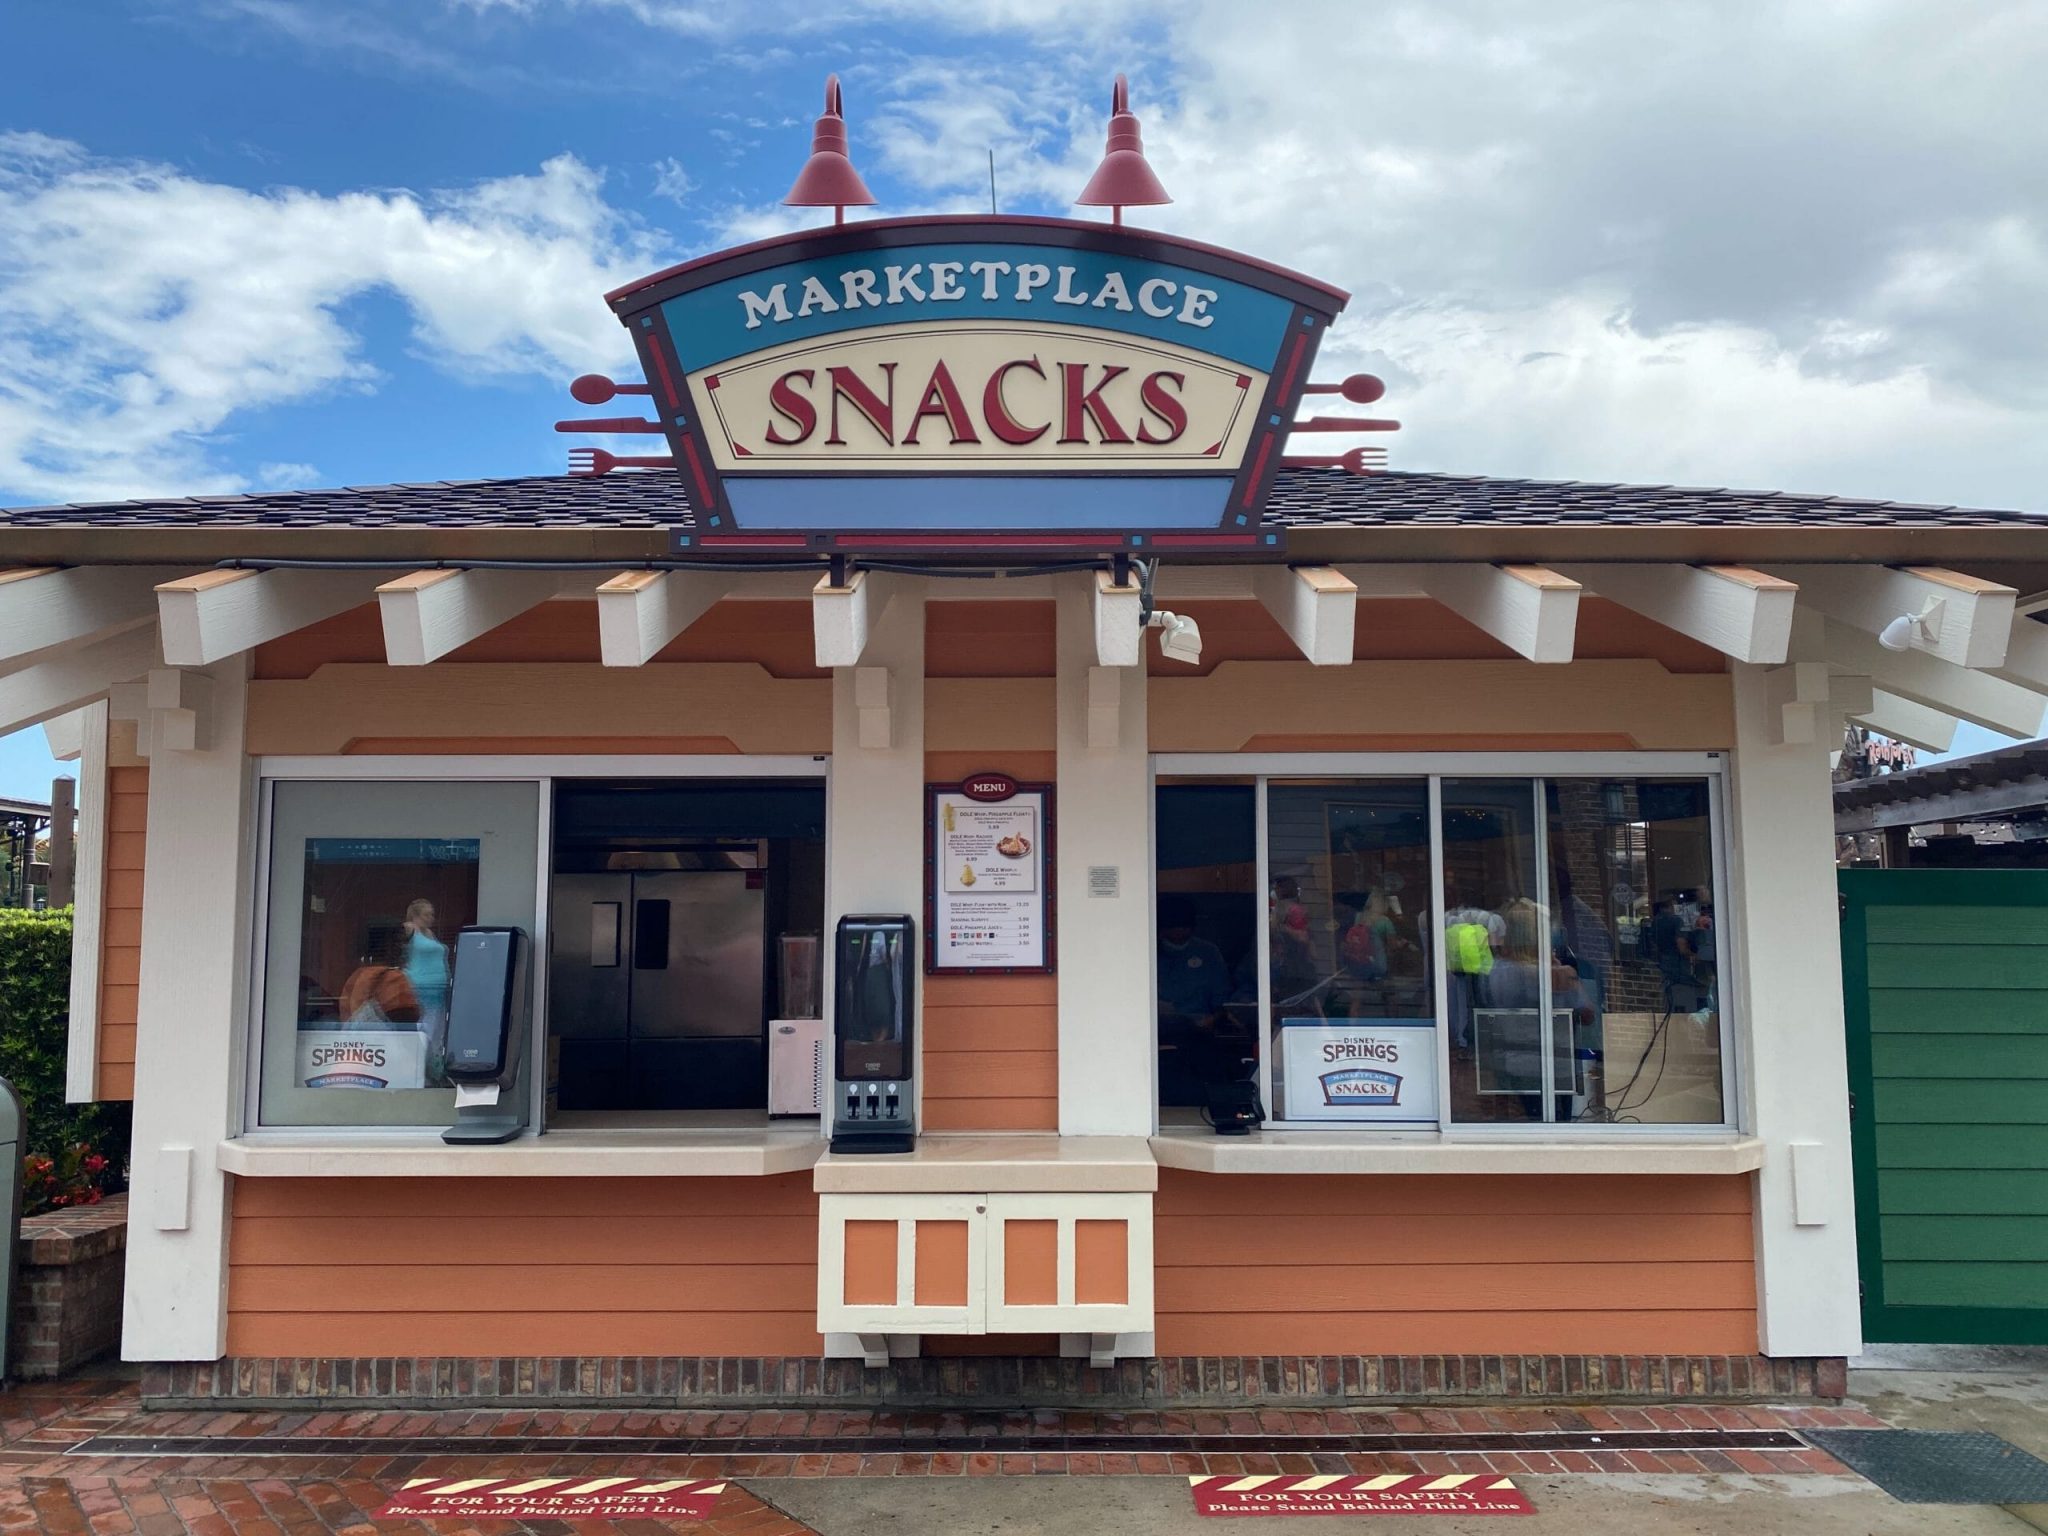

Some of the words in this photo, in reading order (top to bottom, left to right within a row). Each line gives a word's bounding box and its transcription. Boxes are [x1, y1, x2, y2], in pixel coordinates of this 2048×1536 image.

[738, 262, 1219, 329] MARKETPLACE
[765, 353, 1187, 446] SNACKS
[973, 783, 1006, 792] MENU
[311, 1048, 386, 1067] SPRINGS
[1323, 1044, 1399, 1063] SPRINGS
[319, 1076, 374, 1086] MARKETPLACE
[1333, 1072, 1389, 1081] MARKETPLACE
[1335, 1083, 1388, 1094] SNACKS
[430, 1497, 484, 1505] FOR
[494, 1497, 564, 1505] YOUR
[572, 1496, 673, 1505] SAFETY
[1238, 1493, 1294, 1502] FOR
[1297, 1493, 1373, 1501] YOUR
[1379, 1492, 1477, 1500] SAFETY
[386, 1506, 450, 1515] Please
[456, 1506, 517, 1515] Stand
[521, 1506, 595, 1515] Behind
[601, 1505, 646, 1514] This
[652, 1505, 698, 1515] Line
[1208, 1503, 1271, 1511] Please
[1277, 1503, 1336, 1511] Stand
[1341, 1502, 1415, 1511] Behind
[1420, 1502, 1467, 1510] This
[1472, 1502, 1521, 1510] Line
